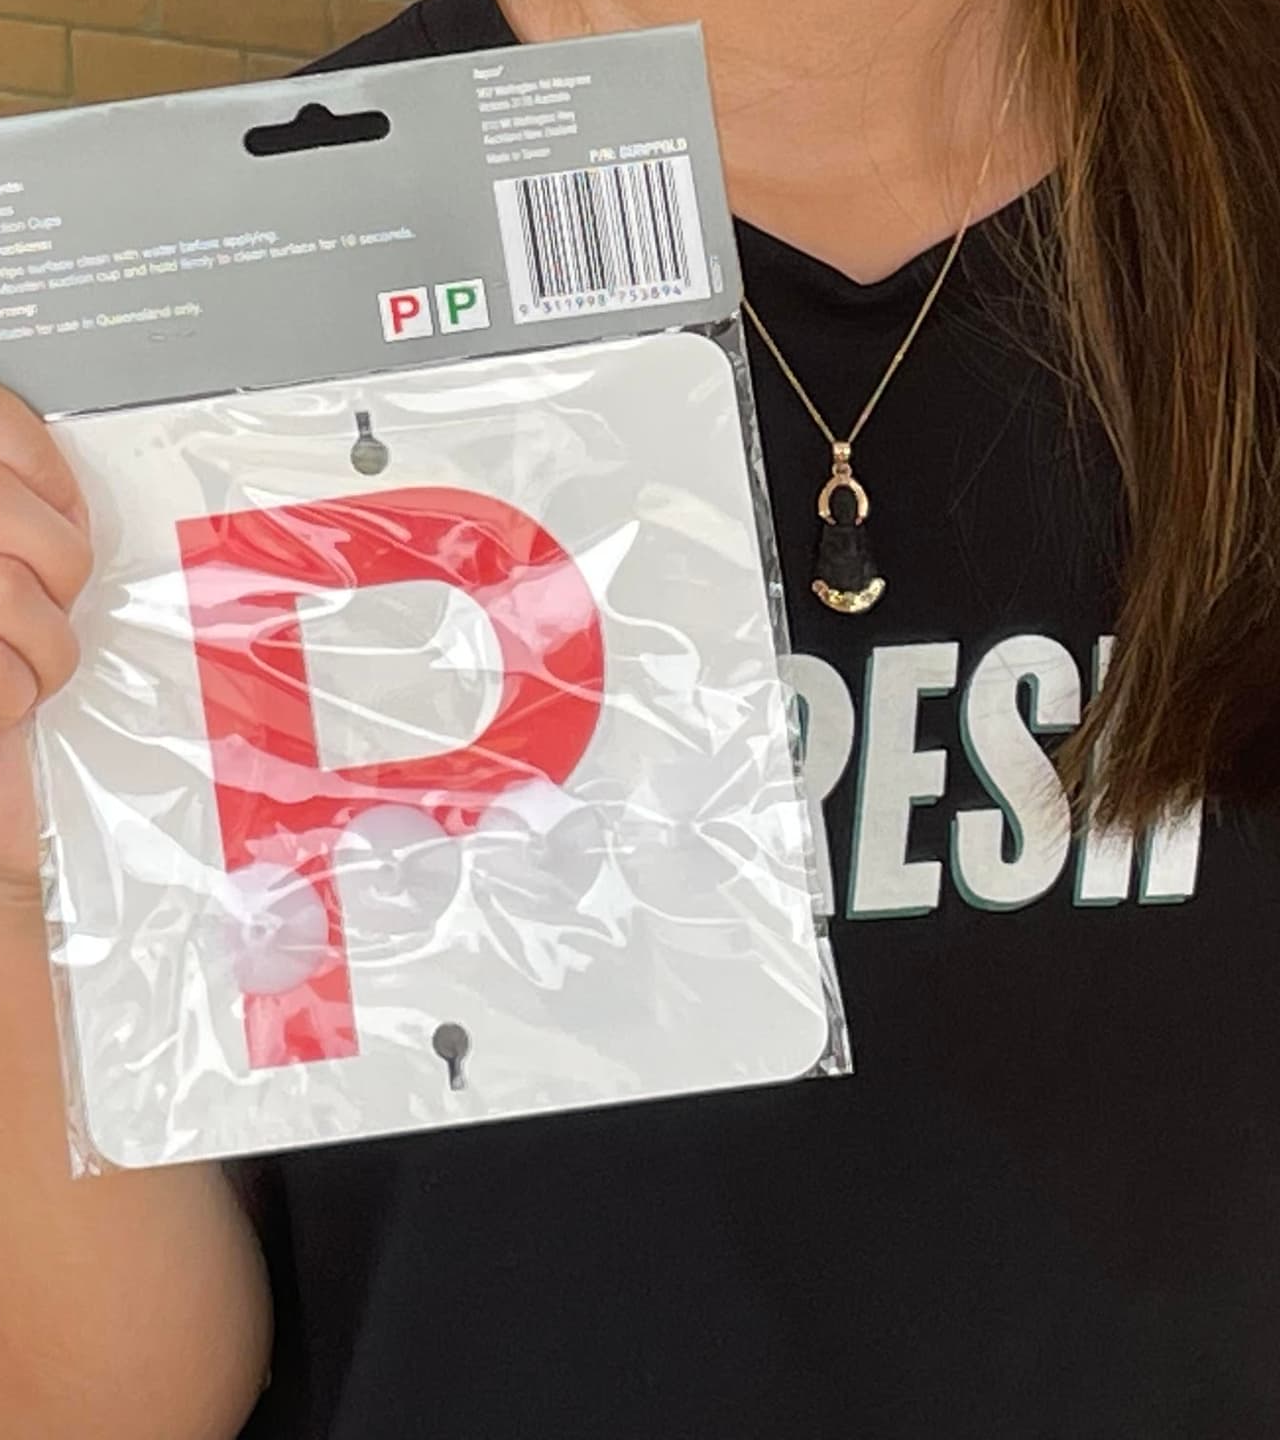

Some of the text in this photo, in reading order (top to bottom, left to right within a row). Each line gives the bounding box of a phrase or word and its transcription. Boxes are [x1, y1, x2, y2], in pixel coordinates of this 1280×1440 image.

[27, 216, 62, 231] Cups
[27, 261, 74, 275] surface
[96, 269, 120, 283] cup
[123, 264, 148, 279] and
[269, 242, 317, 259] surface
[318, 238, 338, 251] for
[96, 306, 172, 328] Queensland
[389, 286, 478, 334] P P
[175, 486, 606, 1071] P
